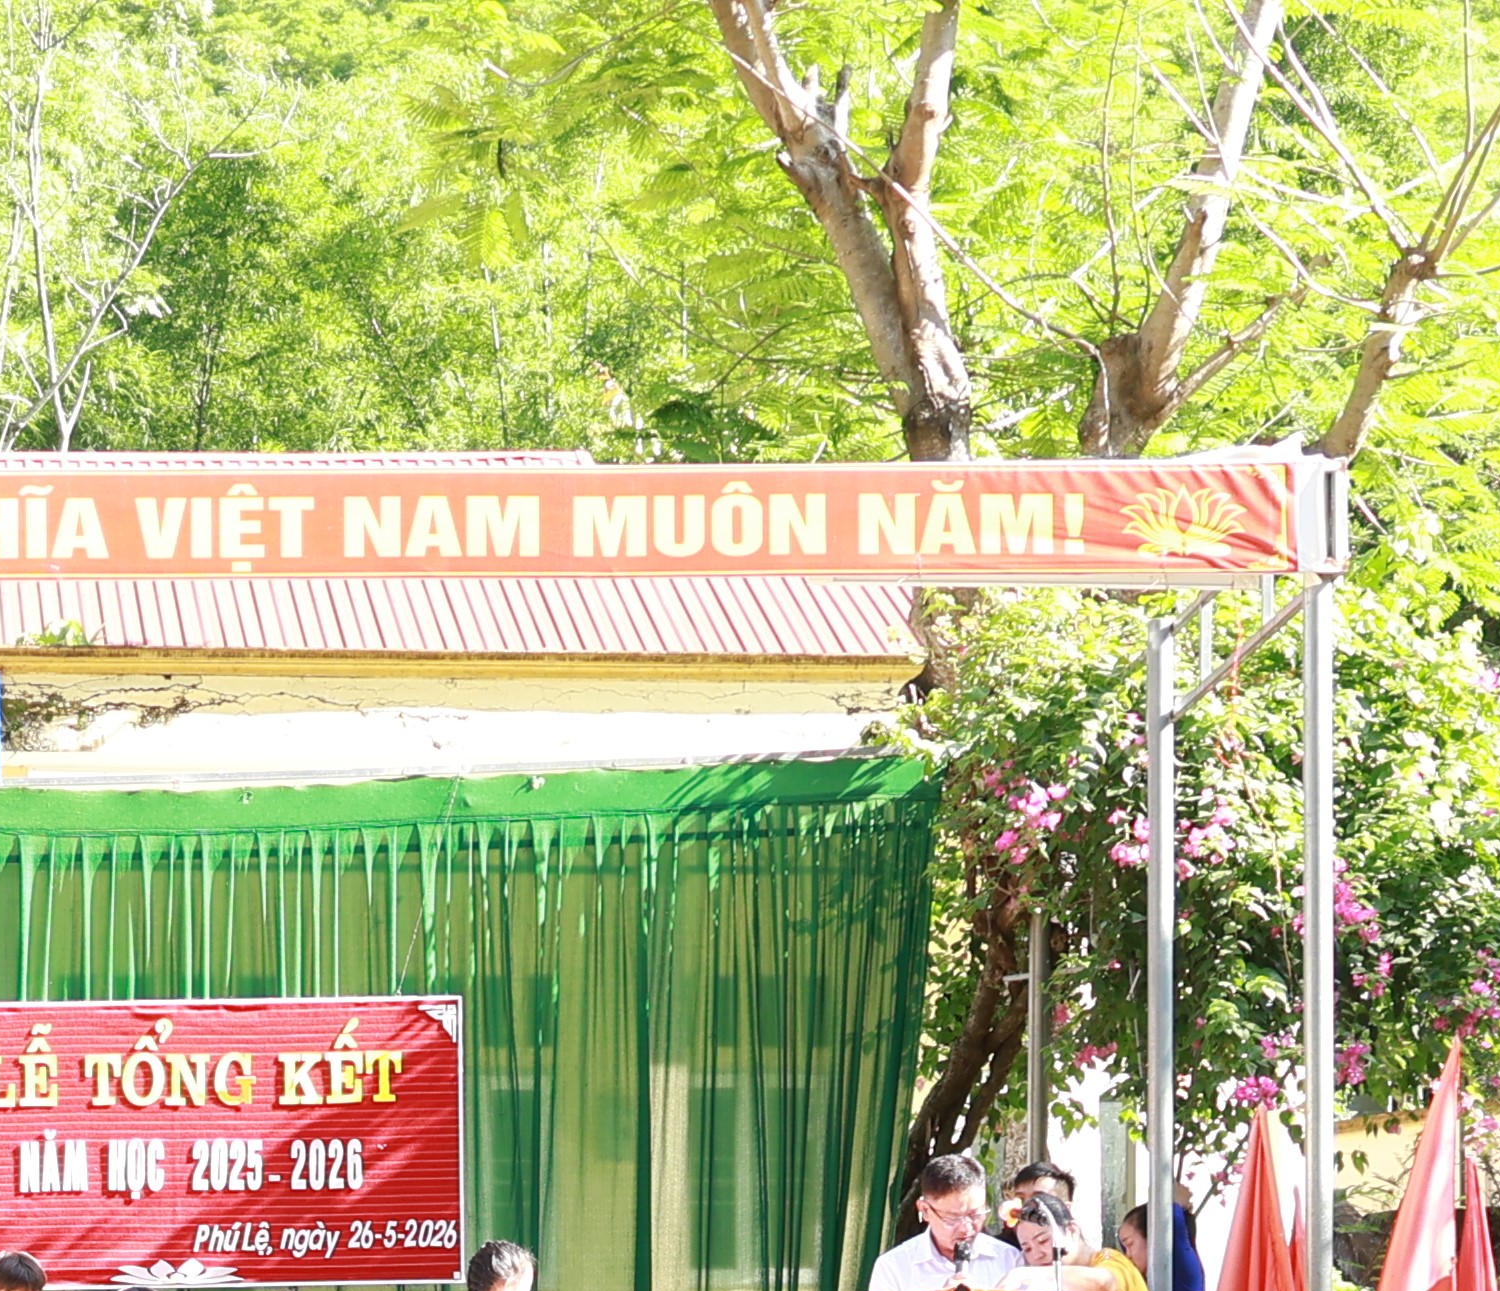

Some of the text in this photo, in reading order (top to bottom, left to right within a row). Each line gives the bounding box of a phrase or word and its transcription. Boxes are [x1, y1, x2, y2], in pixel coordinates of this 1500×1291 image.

[135, 483, 315, 573] VIỆT
[343, 494, 540, 559] NAM
[572, 481, 827, 558] MUÔN
[858, 477, 1085, 556] NĂM!
[84, 1018, 257, 1108] TỔNG
[278, 1018, 404, 1106] KẾT
[18, 1129, 89, 1193] NĂM
[107, 1138, 166, 1200] HỌC
[280, 1220, 341, 1259] ngày
[348, 1219, 458, 1249] 26-5-2026
